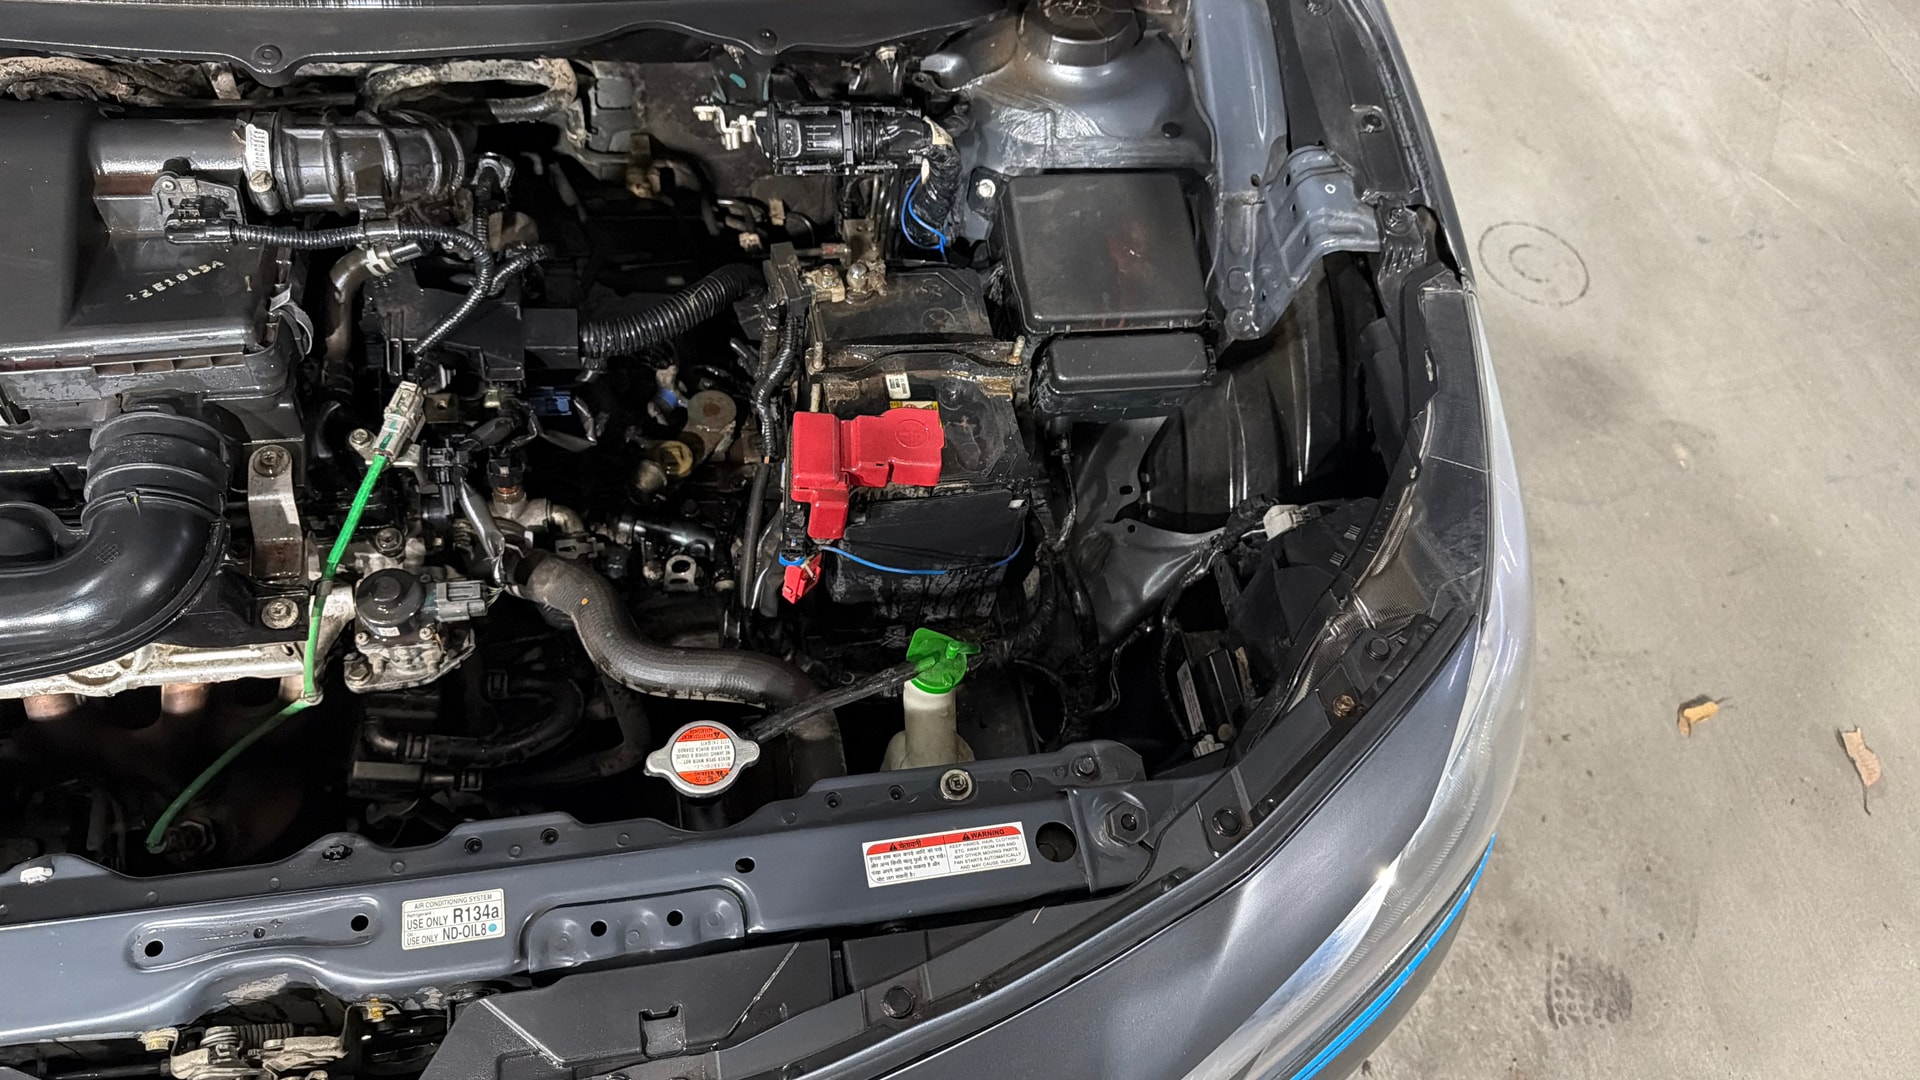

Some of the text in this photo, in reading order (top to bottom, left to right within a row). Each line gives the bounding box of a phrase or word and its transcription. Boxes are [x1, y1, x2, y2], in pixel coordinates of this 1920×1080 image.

[971, 829, 1004, 838] WARNING
[984, 852, 1021, 860] AUTOMATICALLY
[426, 897, 467, 908] CONDITIONING
[469, 894, 492, 902] SYSTEM
[407, 904, 499, 930] USE ONLY R134a
[407, 923, 487, 945] USE ONLY ND-OIL8
